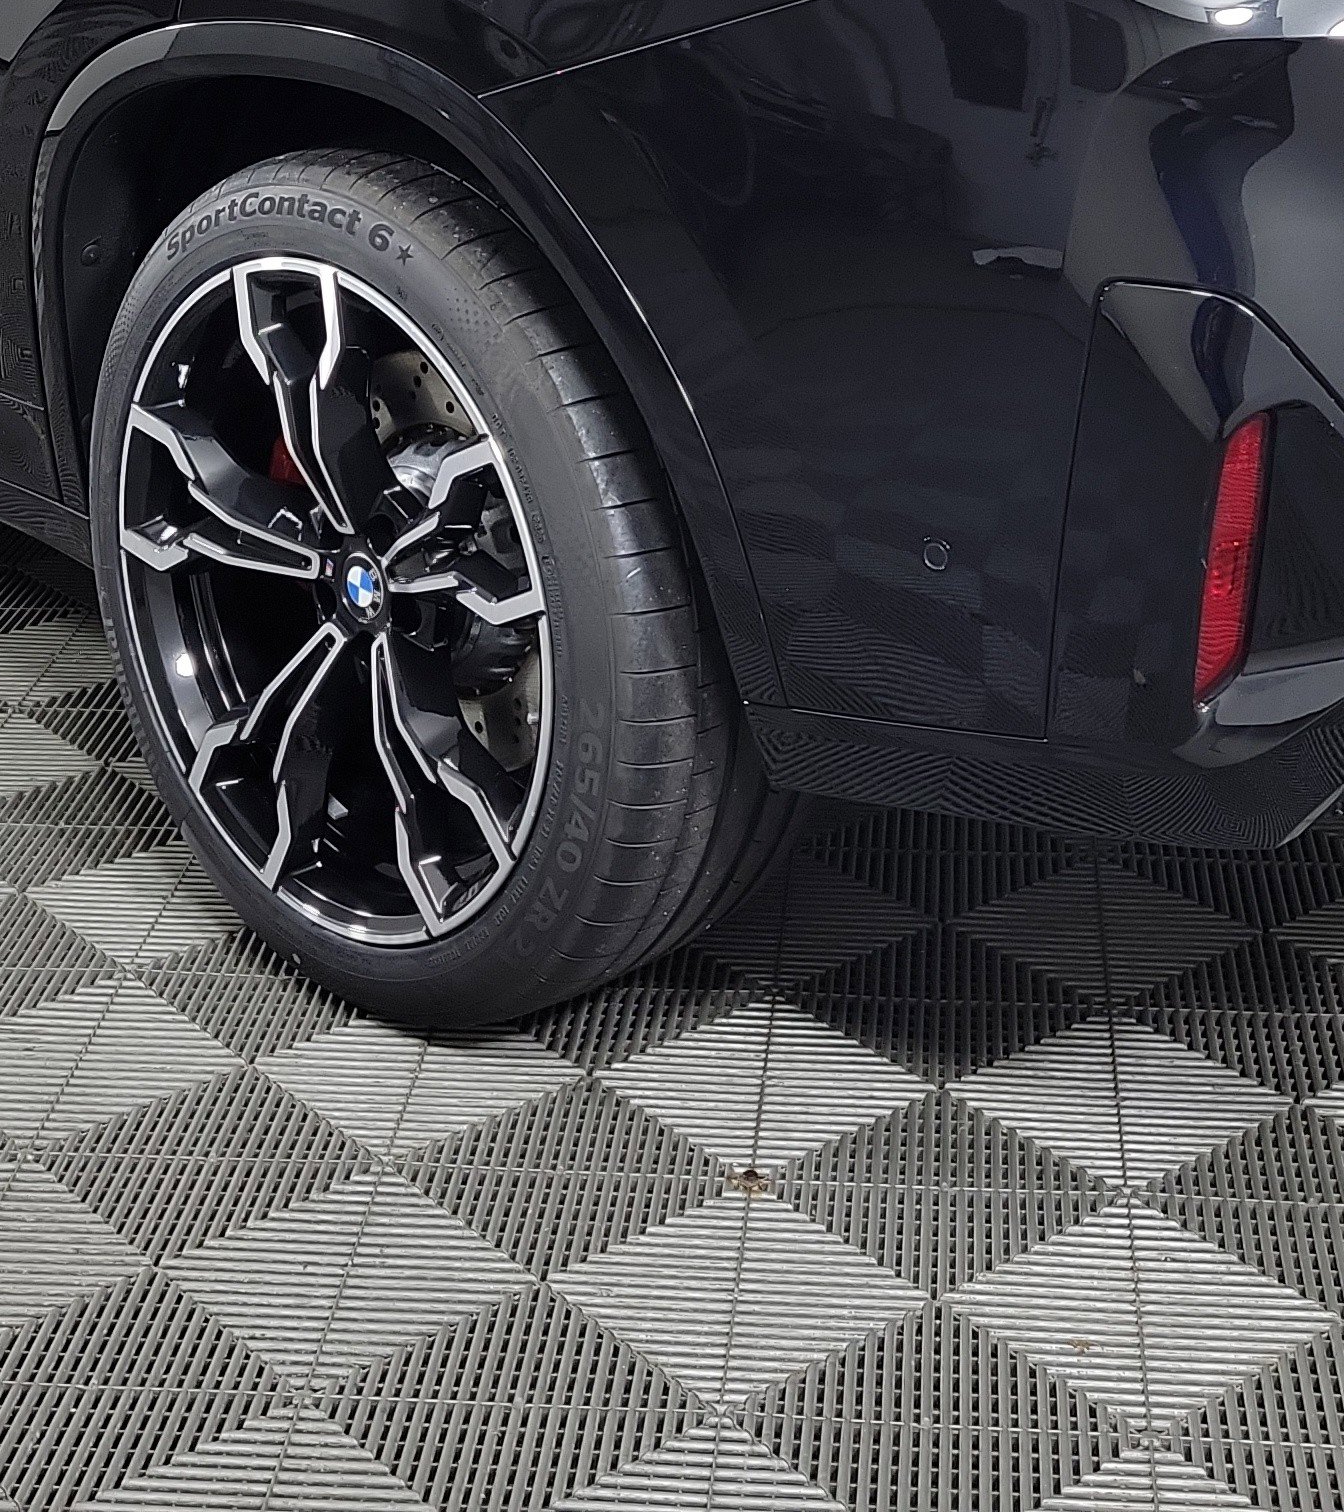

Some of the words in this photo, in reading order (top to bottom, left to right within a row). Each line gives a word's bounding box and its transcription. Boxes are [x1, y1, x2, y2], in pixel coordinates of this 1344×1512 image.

[166, 192, 362, 261] SportContact
[368, 223, 395, 252] 6
[557, 699, 604, 873] 265/40
